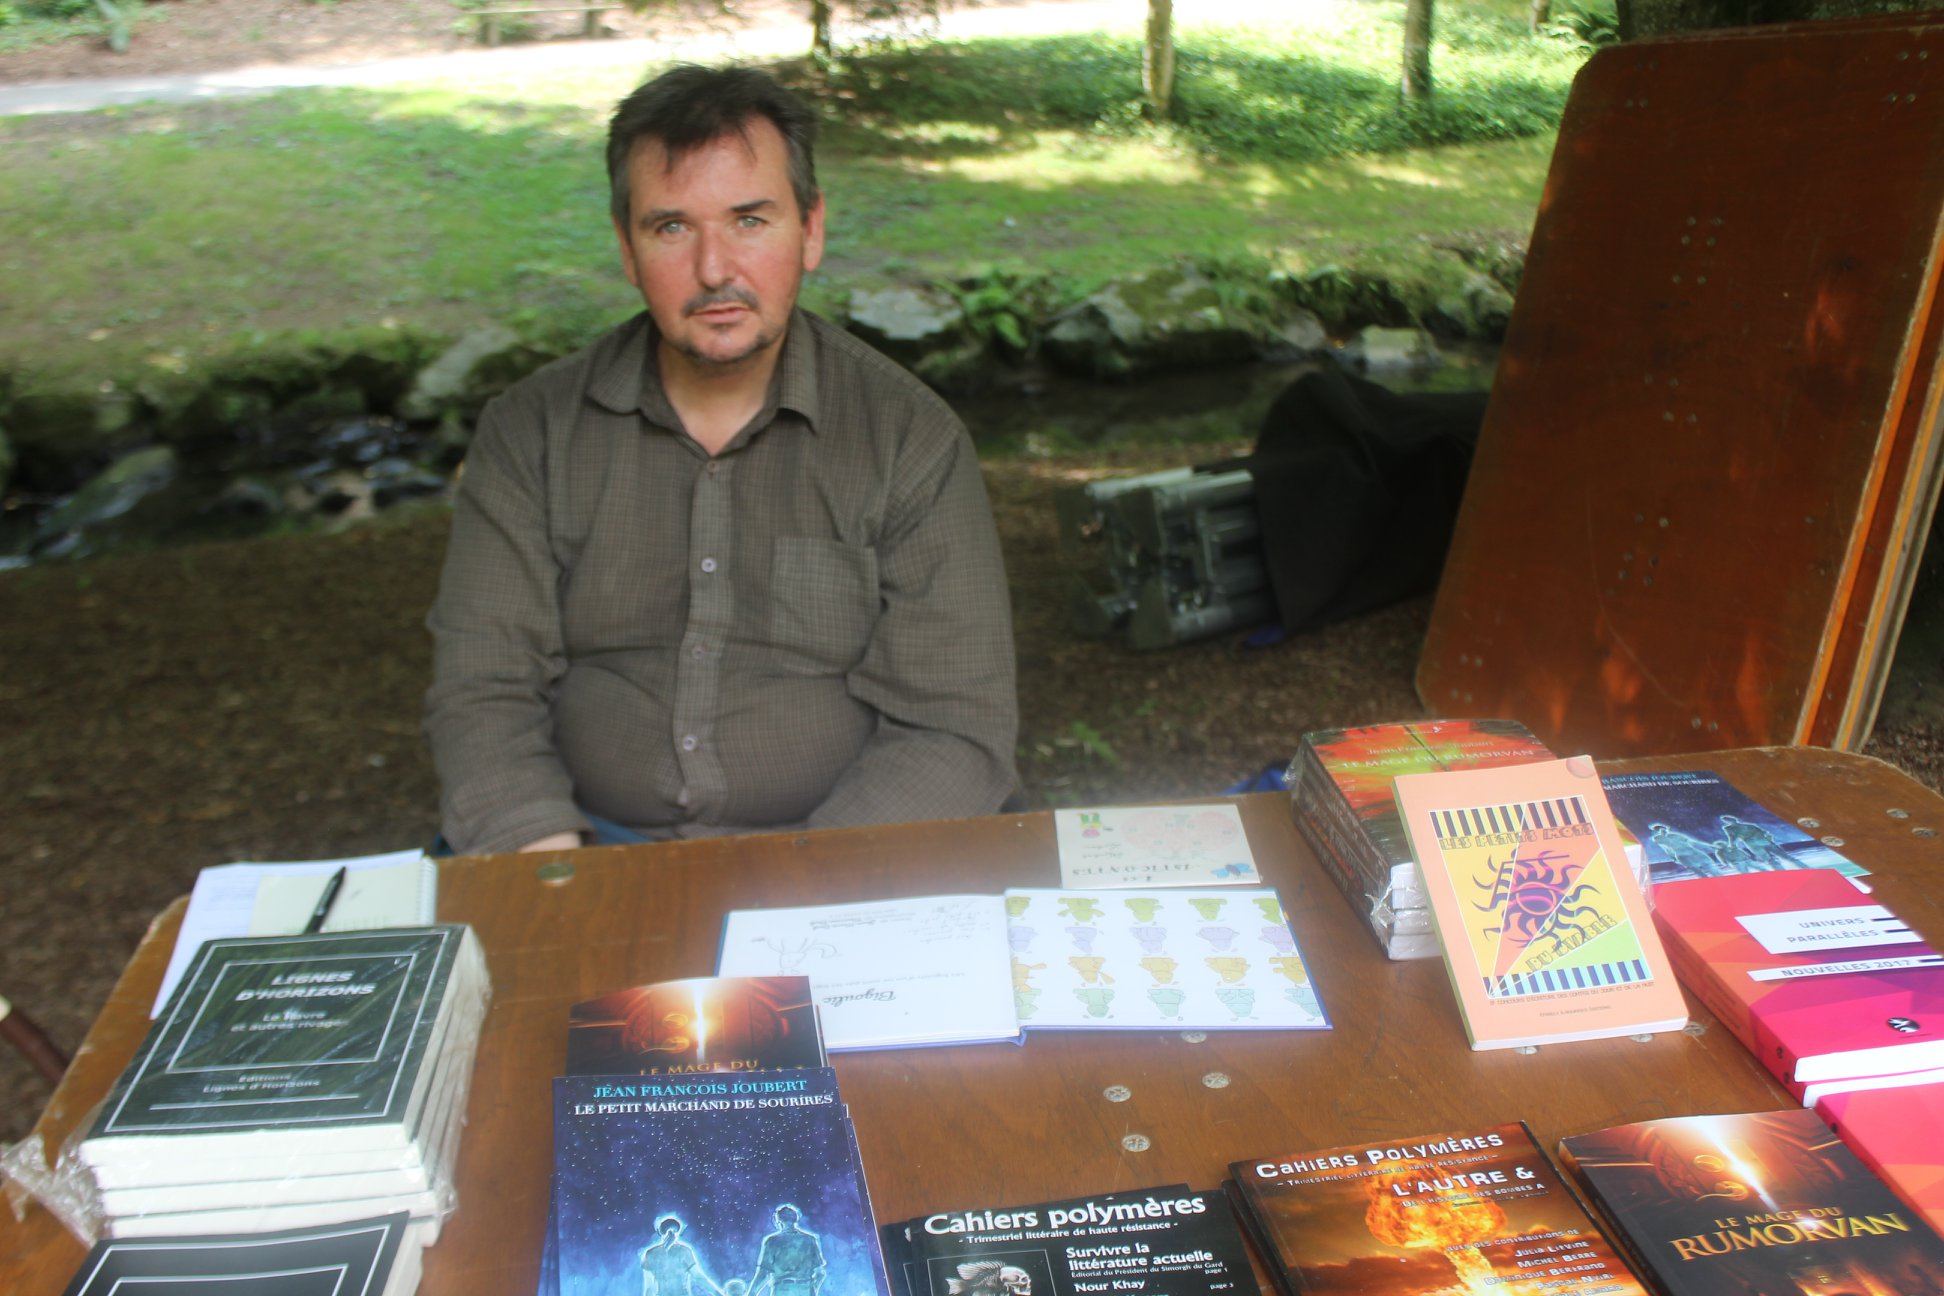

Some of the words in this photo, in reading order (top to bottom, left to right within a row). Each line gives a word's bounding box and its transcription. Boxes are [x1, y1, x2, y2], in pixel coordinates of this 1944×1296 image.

[1438, 834, 1472, 851] LES
[1475, 829, 1538, 849] PETITS
[1542, 822, 1595, 842] MOTS
[1798, 917, 1866, 929] UNIVERS
[1786, 929, 1880, 944] PARALLÈLES
[1780, 962, 1871, 977] NOUVELLES
[1873, 959, 1911, 969] 2017
[270, 970, 356, 986] LIGNES
[234, 983, 378, 1002] D'HORIZONS
[263, 1011, 280, 1022] Le
[667, 1062, 722, 1074] MAGE
[730, 1059, 758, 1070] DU
[593, 1085, 637, 1098] JEAN
[640, 1083, 728, 1097] FRANCOIS
[731, 1080, 808, 1095] JOUBERT
[574, 1104, 596, 1116] LE
[597, 1102, 642, 1115] PETIT
[644, 1099, 731, 1113] MARCHAND
[733, 1098, 756, 1110] DE
[758, 1095, 834, 1109] SOURIRES
[1392, 1170, 1508, 1197] L'AUTRE
[1514, 1166, 1537, 1180] &
[1494, 1184, 1534, 1195] BOMBES
[924, 1210, 1039, 1236] Cahiers
[1048, 1197, 1207, 1229] polymères
[1714, 1216, 1743, 1230] LE
[1745, 1208, 1803, 1226] MAGE
[1809, 1206, 1843, 1219] DU
[966, 1232, 1023, 1244] Trimestriel
[1025, 1229, 1070, 1240] littéraire
[1072, 1228, 1086, 1237] de
[1089, 1226, 1119, 1236] haute
[1121, 1221, 1171, 1233] résistance
[1668, 1212, 1913, 1262] RUMORVAN
[1066, 1244, 1131, 1259] Survivre
[1135, 1242, 1150, 1254] la
[1068, 1255, 1148, 1271] littérature
[1152, 1250, 1214, 1265] actuelle
[1103, 1269, 1114, 1277] du
[1115, 1267, 1148, 1276] Président
[1150, 1265, 1160, 1273] du
[1161, 1263, 1192, 1273] Simorgh
[1193, 1262, 1203, 1270] du
[1204, 1261, 1224, 1269] Gard
[1204, 1268, 1222, 1276] page
[1073, 1281, 1110, 1293] Nour
[1113, 1279, 1146, 1291] Khay
[1209, 1282, 1228, 1290] page
